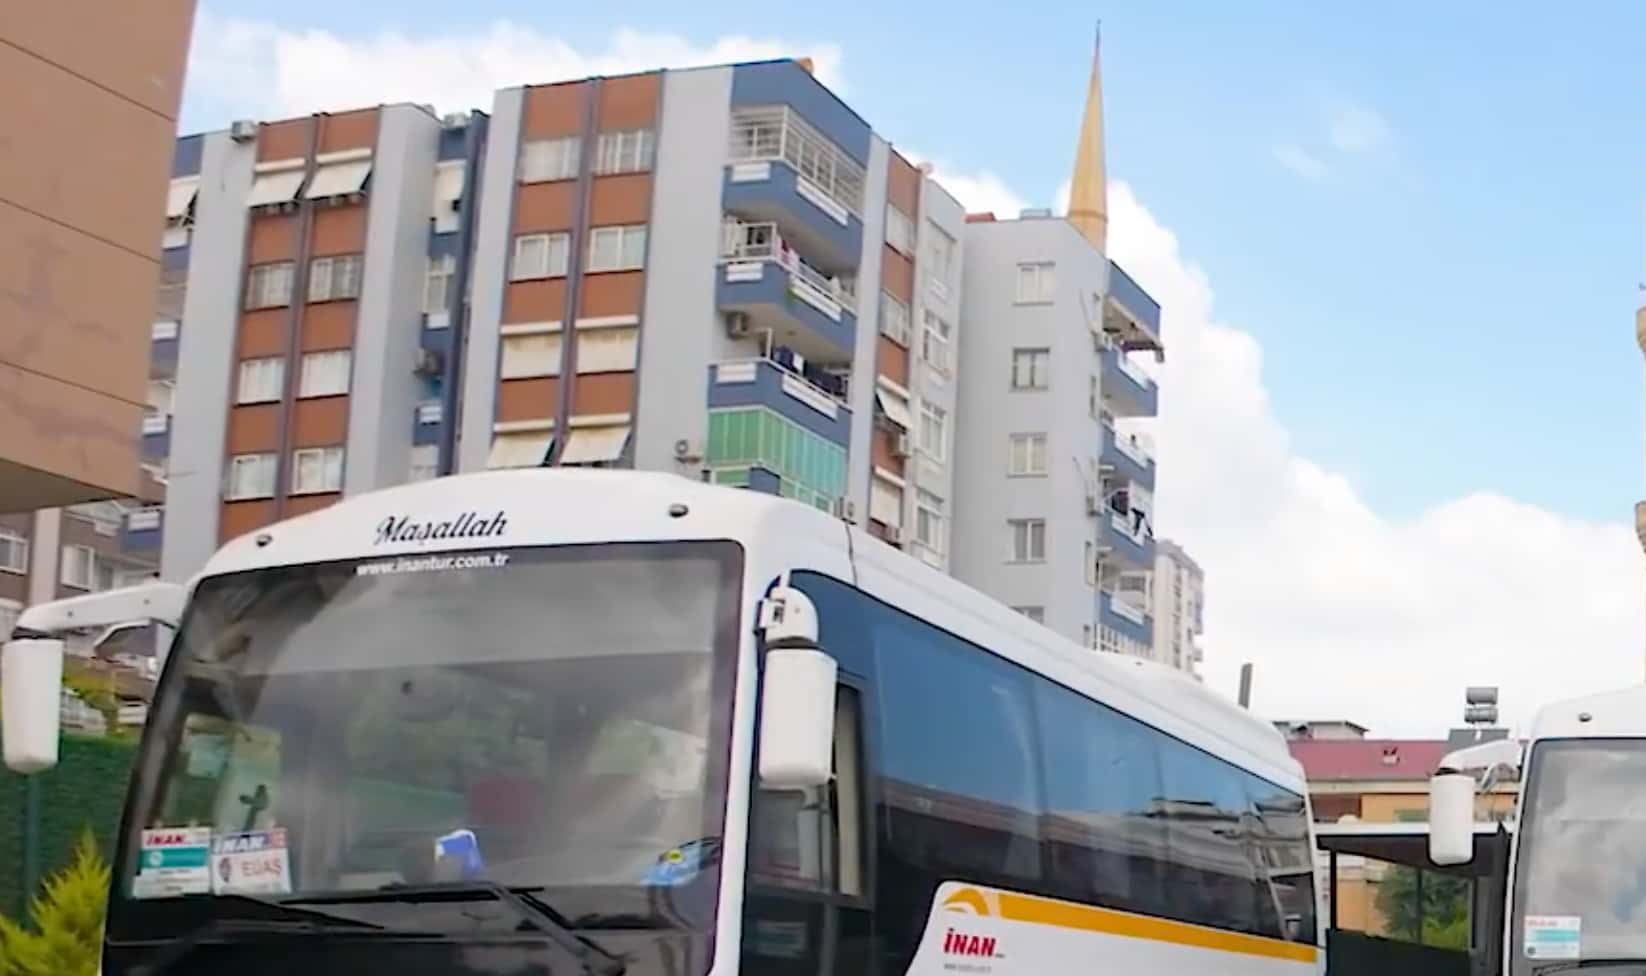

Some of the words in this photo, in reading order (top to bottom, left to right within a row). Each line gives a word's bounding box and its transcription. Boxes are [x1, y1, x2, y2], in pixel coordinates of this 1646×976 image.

[374, 510, 507, 546] Maşallah
[356, 553, 509, 576] www.inantur.com.tr
[943, 927, 996, 957] İNAN
